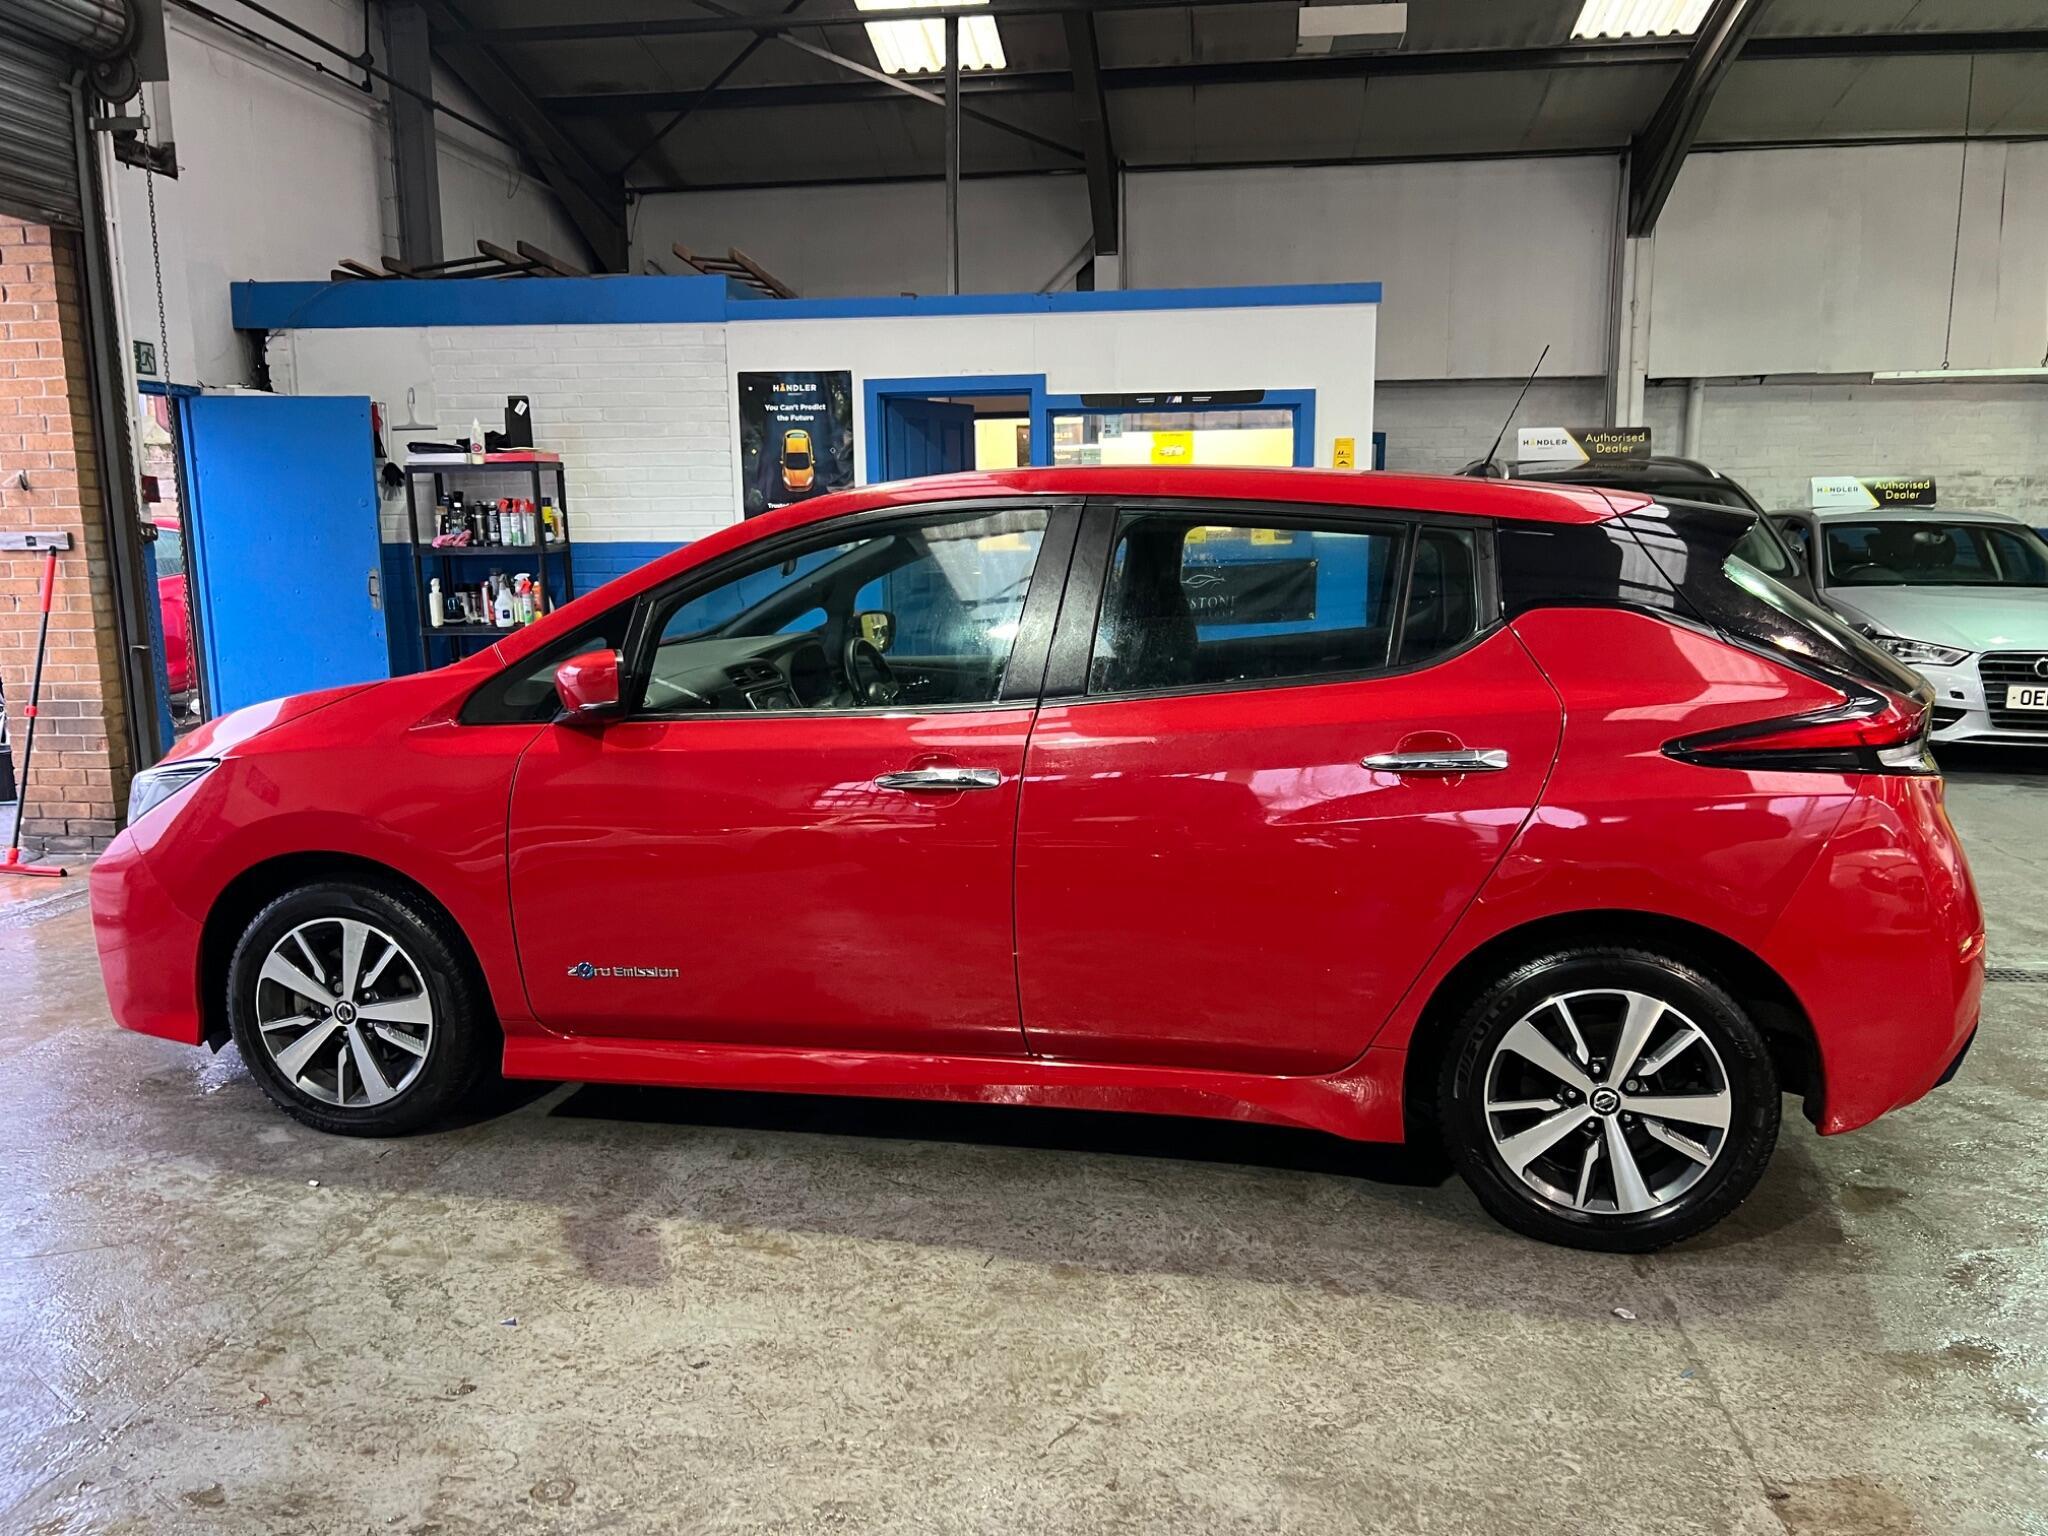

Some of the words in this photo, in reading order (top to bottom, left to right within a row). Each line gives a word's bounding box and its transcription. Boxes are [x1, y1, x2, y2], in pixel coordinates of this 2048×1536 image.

[800, 403, 826, 411] Predict
[1585, 432, 1645, 442] Authorised
[1596, 443, 1633, 453] Dealer
[1874, 480, 1930, 490] Authorised
[1885, 490, 1920, 500] Dealer
[2020, 689, 2048, 707] OE
[613, 966, 680, 978] Emission
